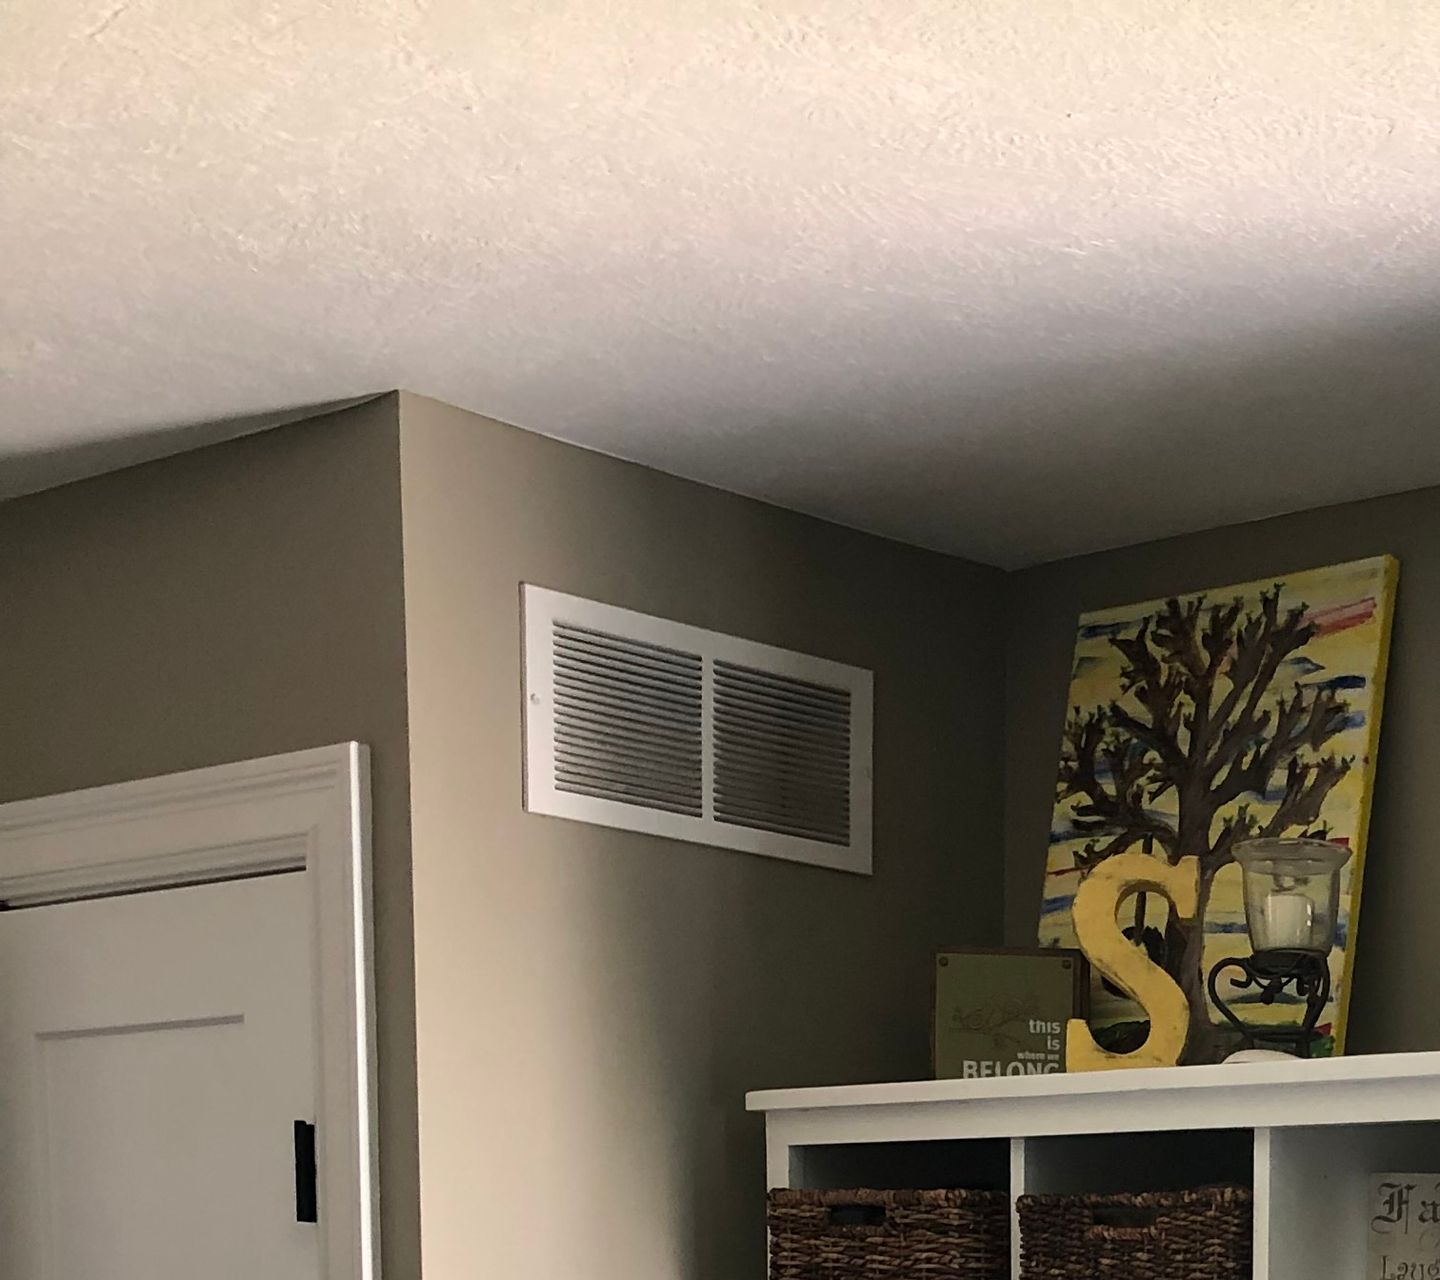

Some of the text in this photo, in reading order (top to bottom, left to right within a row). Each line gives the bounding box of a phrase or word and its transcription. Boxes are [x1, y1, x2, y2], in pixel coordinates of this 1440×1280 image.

[1065, 853, 1201, 1074] S
[1028, 1019, 1061, 1034] this
[1046, 1035, 1061, 1051] is
[962, 1060, 1060, 1079] BELONG
